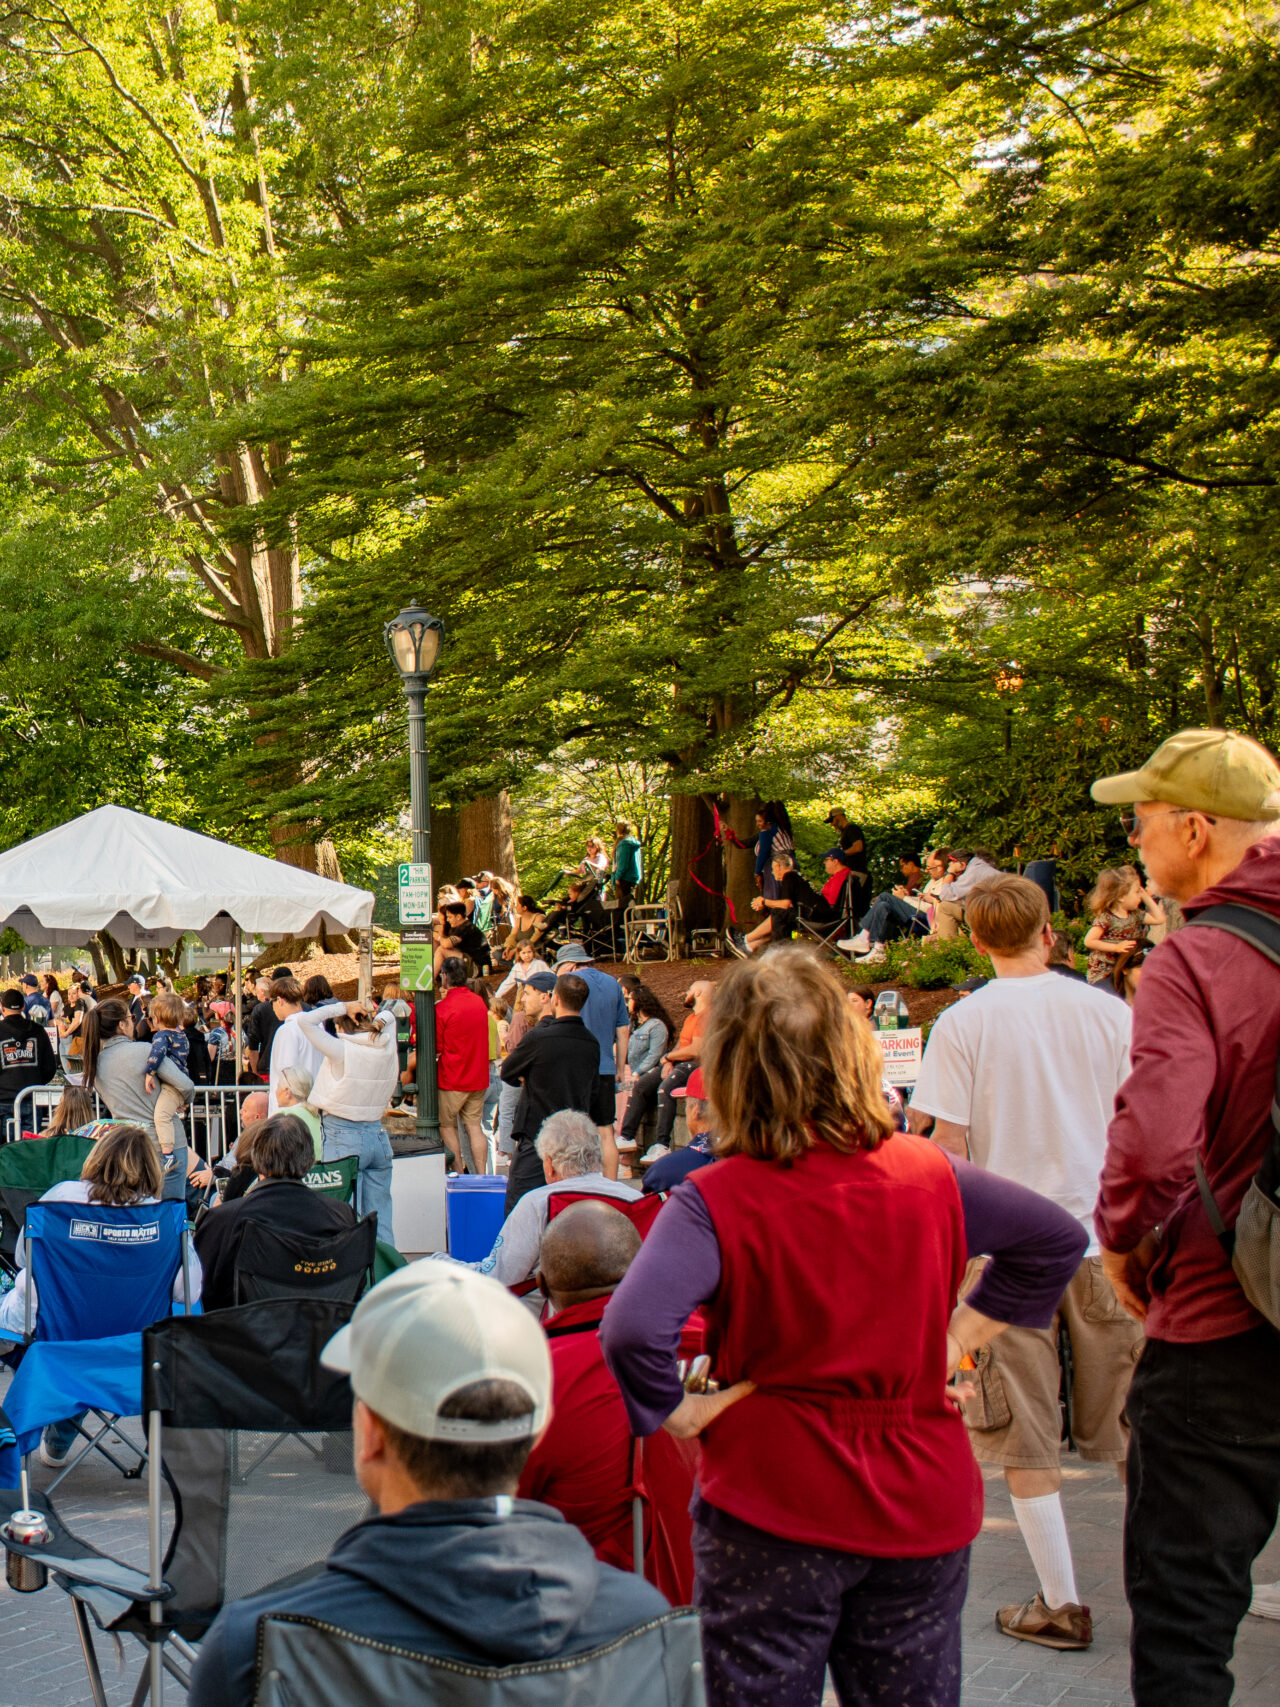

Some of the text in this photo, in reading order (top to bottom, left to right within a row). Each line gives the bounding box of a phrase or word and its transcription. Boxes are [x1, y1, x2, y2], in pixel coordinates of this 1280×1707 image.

[401, 869, 408, 883] 2
[880, 1038, 920, 1051] ARKING
[302, 1170, 342, 1184] YAN'S
[103, 1227, 130, 1238] SPORTS
